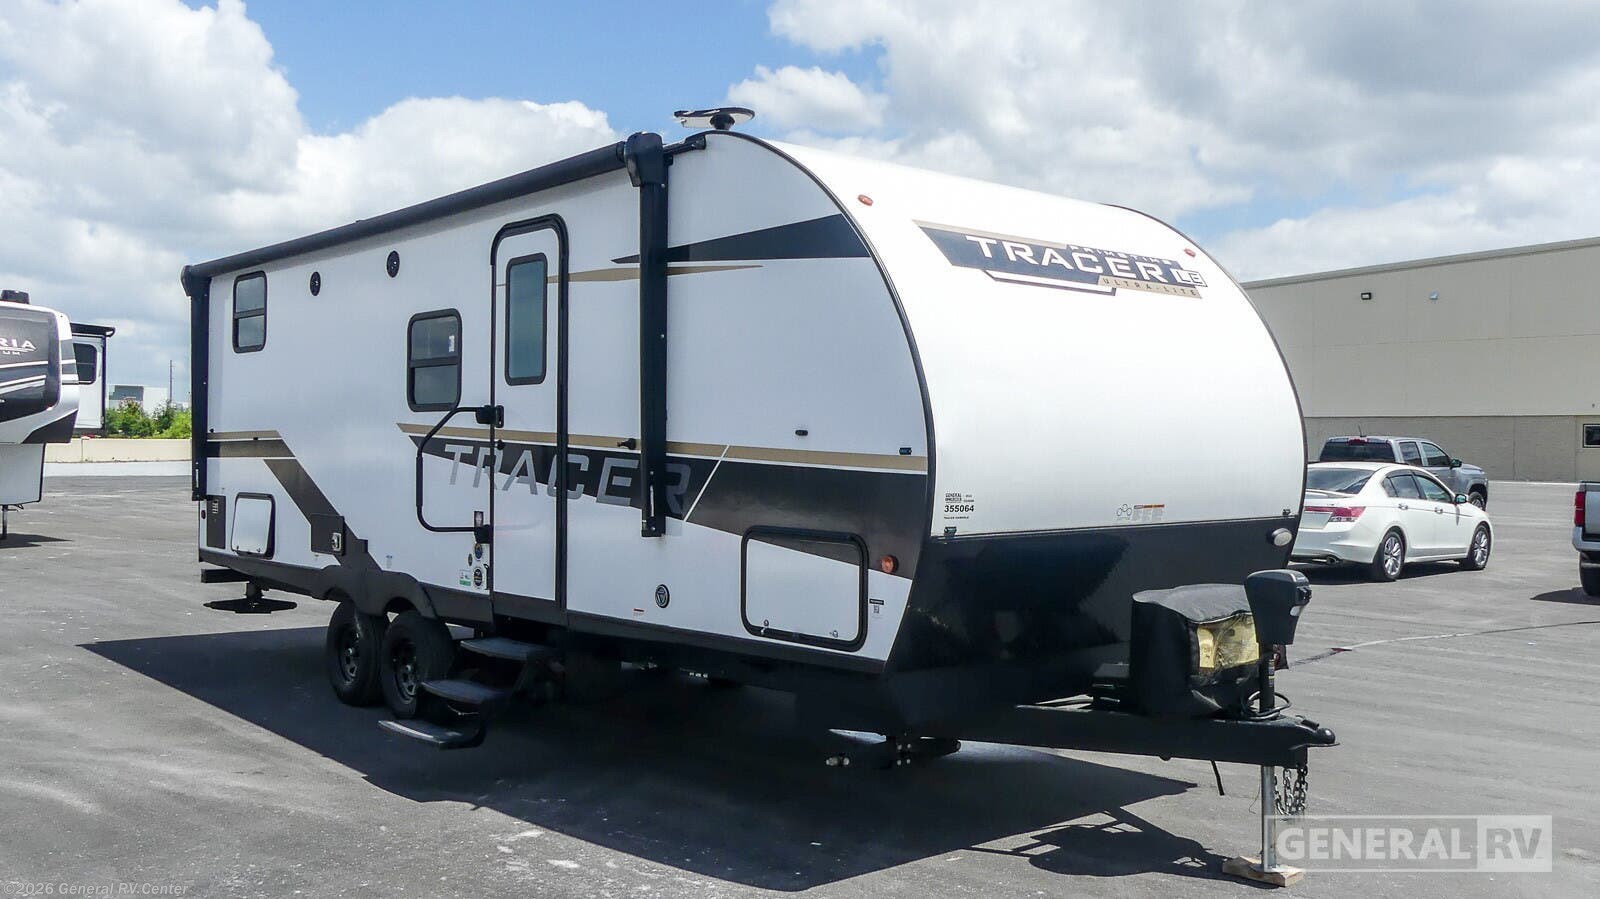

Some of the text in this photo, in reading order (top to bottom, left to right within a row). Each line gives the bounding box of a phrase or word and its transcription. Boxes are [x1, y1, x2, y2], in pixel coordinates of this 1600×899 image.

[965, 235, 1169, 283] TRACER
[1102, 277, 1198, 296] ULTRA-LITE
[444, 444, 691, 515] TRACER
[944, 504, 975, 513] 355064
